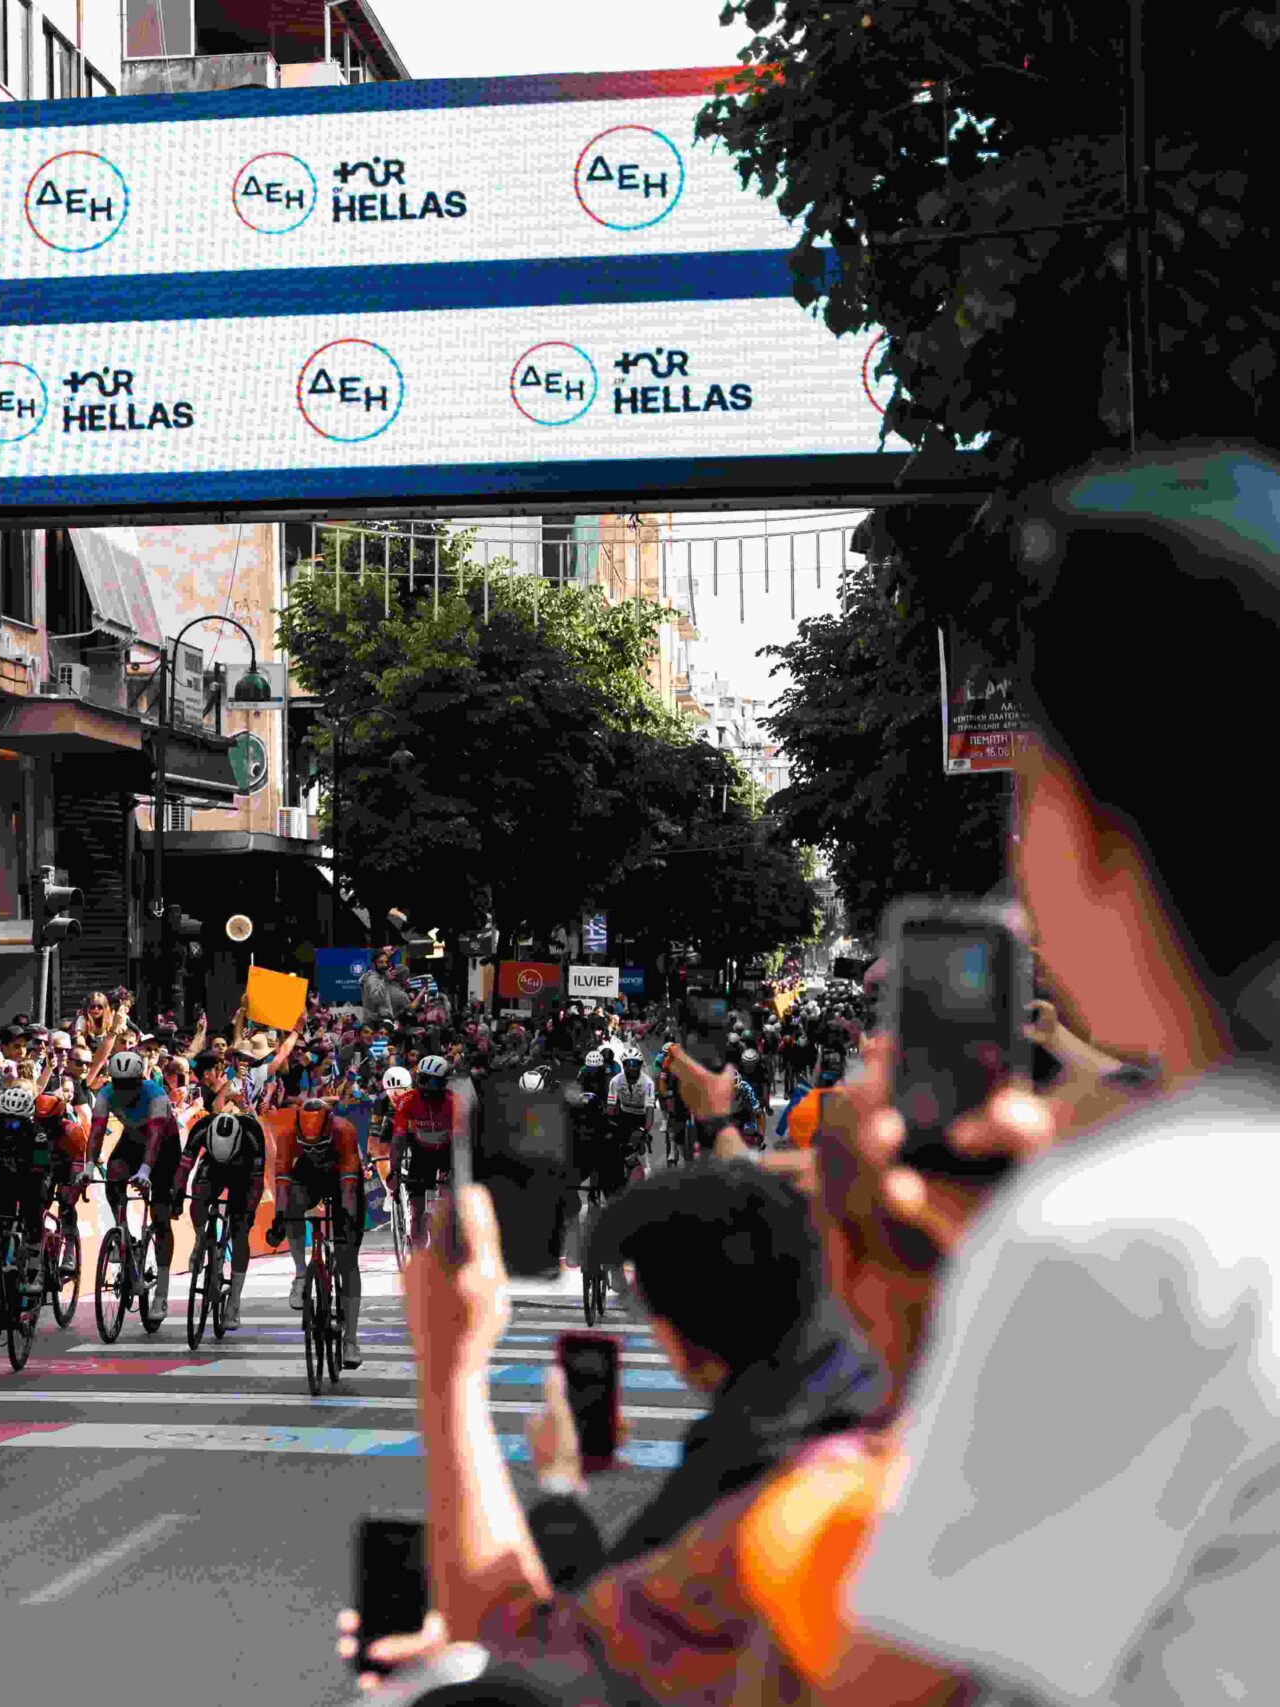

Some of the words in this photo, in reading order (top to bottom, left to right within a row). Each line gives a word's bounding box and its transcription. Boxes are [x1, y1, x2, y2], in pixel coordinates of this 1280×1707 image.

[332, 191, 468, 222] HELLAS
[614, 384, 753, 414] HELLAS
[63, 402, 194, 433] HELLAS
[970, 734, 1008, 745] ΠΕΜΠΤΗ
[574, 975, 614, 987] ILVIEF
